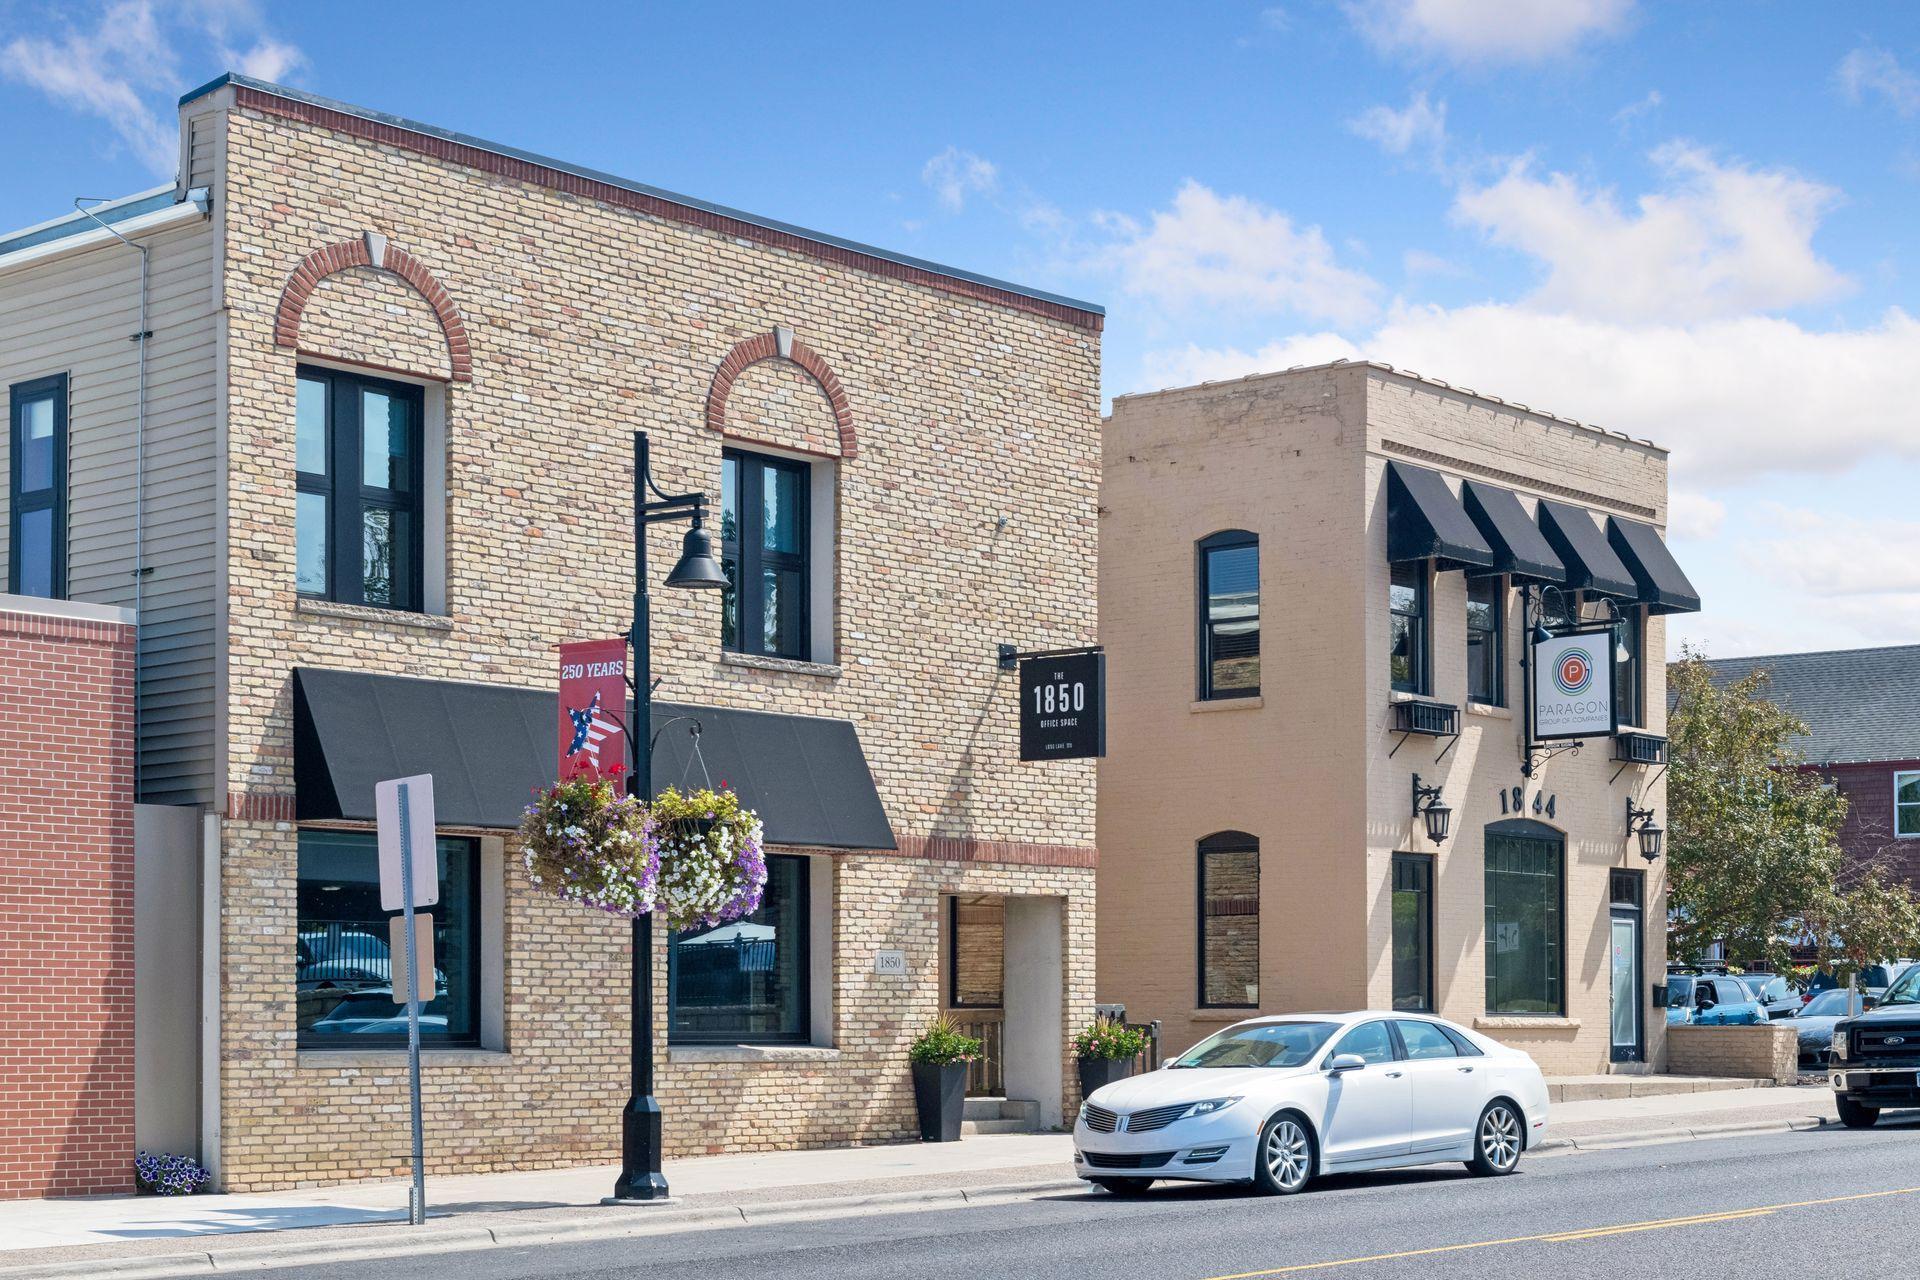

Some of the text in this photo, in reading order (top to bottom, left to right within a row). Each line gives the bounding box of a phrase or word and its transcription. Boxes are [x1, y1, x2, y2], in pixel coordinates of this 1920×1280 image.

[562, 660, 624, 679] 250 YEARS
[1054, 672, 1064, 680] THE
[1569, 665, 1579, 678] P
[1034, 682, 1084, 714] 1850
[1539, 700, 1608, 716] PARAGON
[1040, 717, 1078, 728] OFFICE SPACE
[1573, 714, 1608, 723] COMPANIES
[1499, 786, 1556, 819] 1844
[880, 956, 900, 968] 1850
